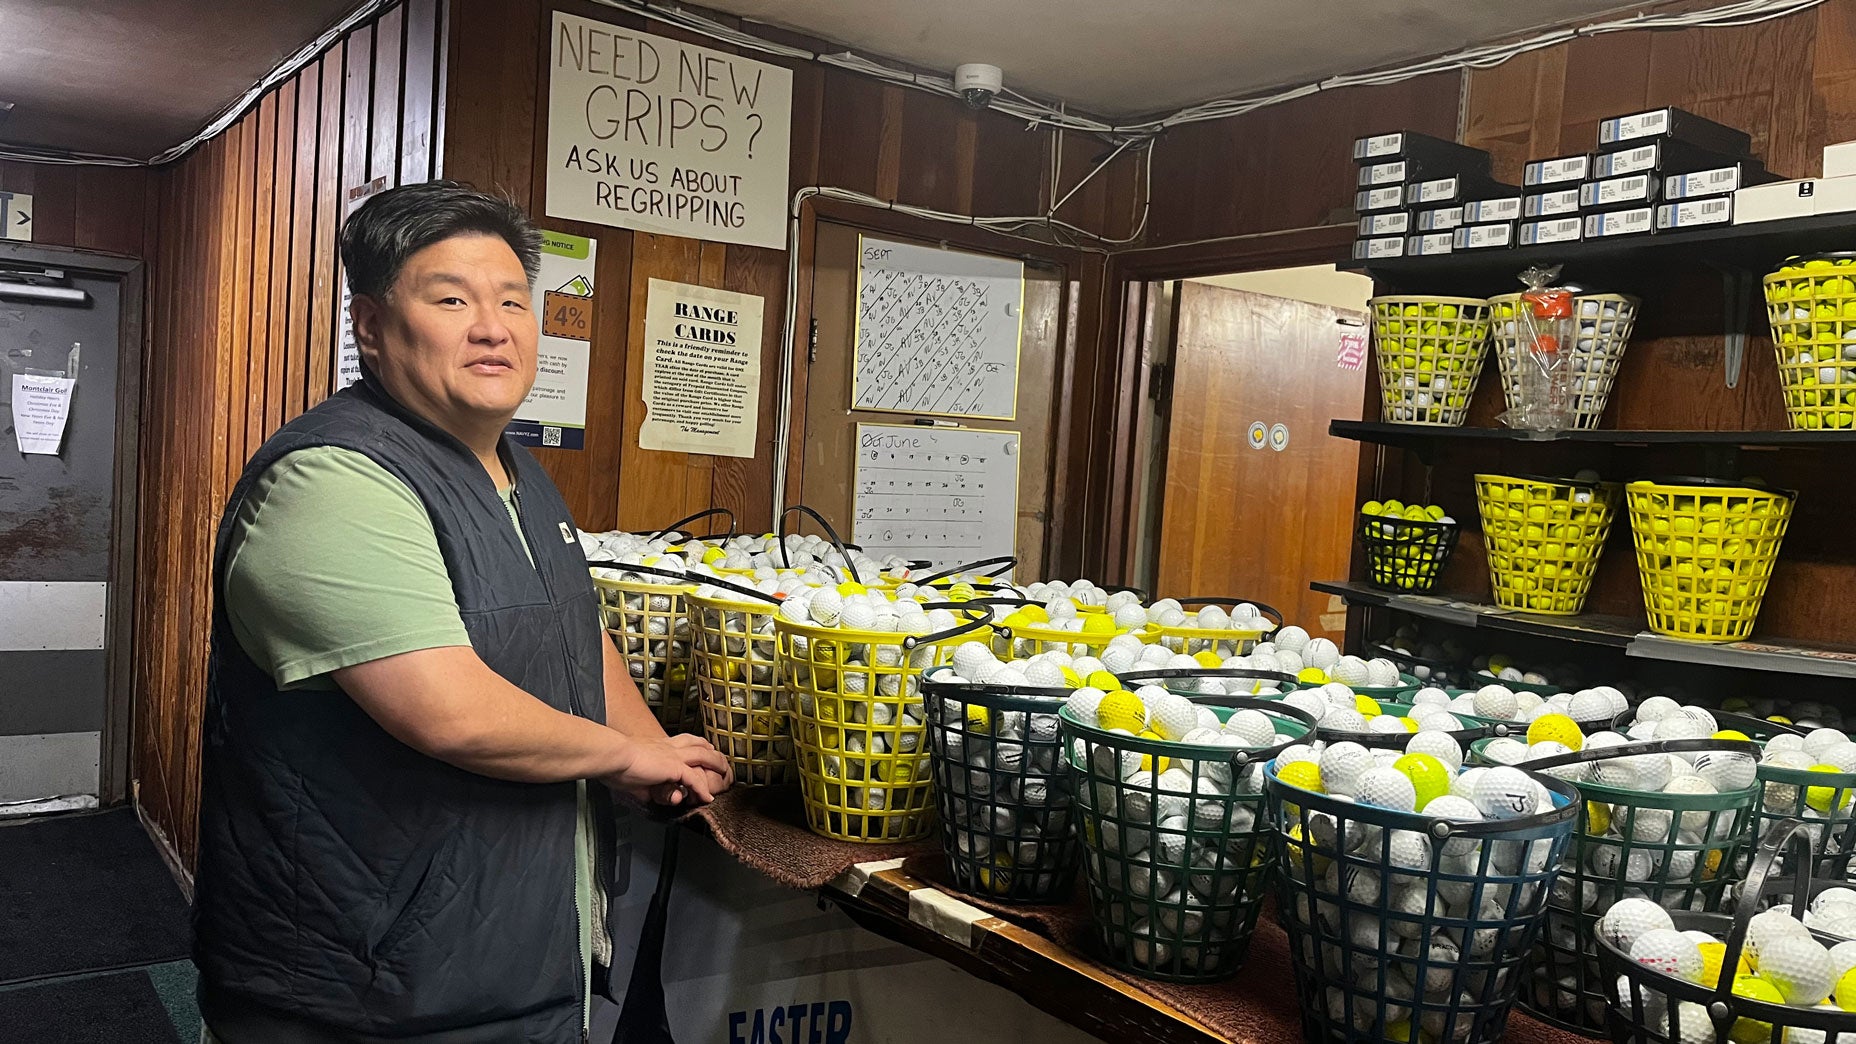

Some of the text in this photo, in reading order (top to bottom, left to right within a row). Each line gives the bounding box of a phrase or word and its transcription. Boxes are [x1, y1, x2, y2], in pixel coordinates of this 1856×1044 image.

[558, 22, 762, 109] NEED NEW
[586, 85, 728, 152] GRIPS
[565, 144, 742, 196] ASK US ABOUT
[596, 181, 745, 228] REGRIPPING
[552, 241, 574, 250] NOTICE
[864, 248, 892, 260] SEPT
[554, 306, 586, 329] 4%
[675, 302, 738, 325] RANGE
[675, 324, 736, 344] CARDS
[685, 344, 710, 352] friendly
[540, 367, 565, 375] discount.
[690, 426, 720, 435] Management
[885, 435, 921, 448] June
